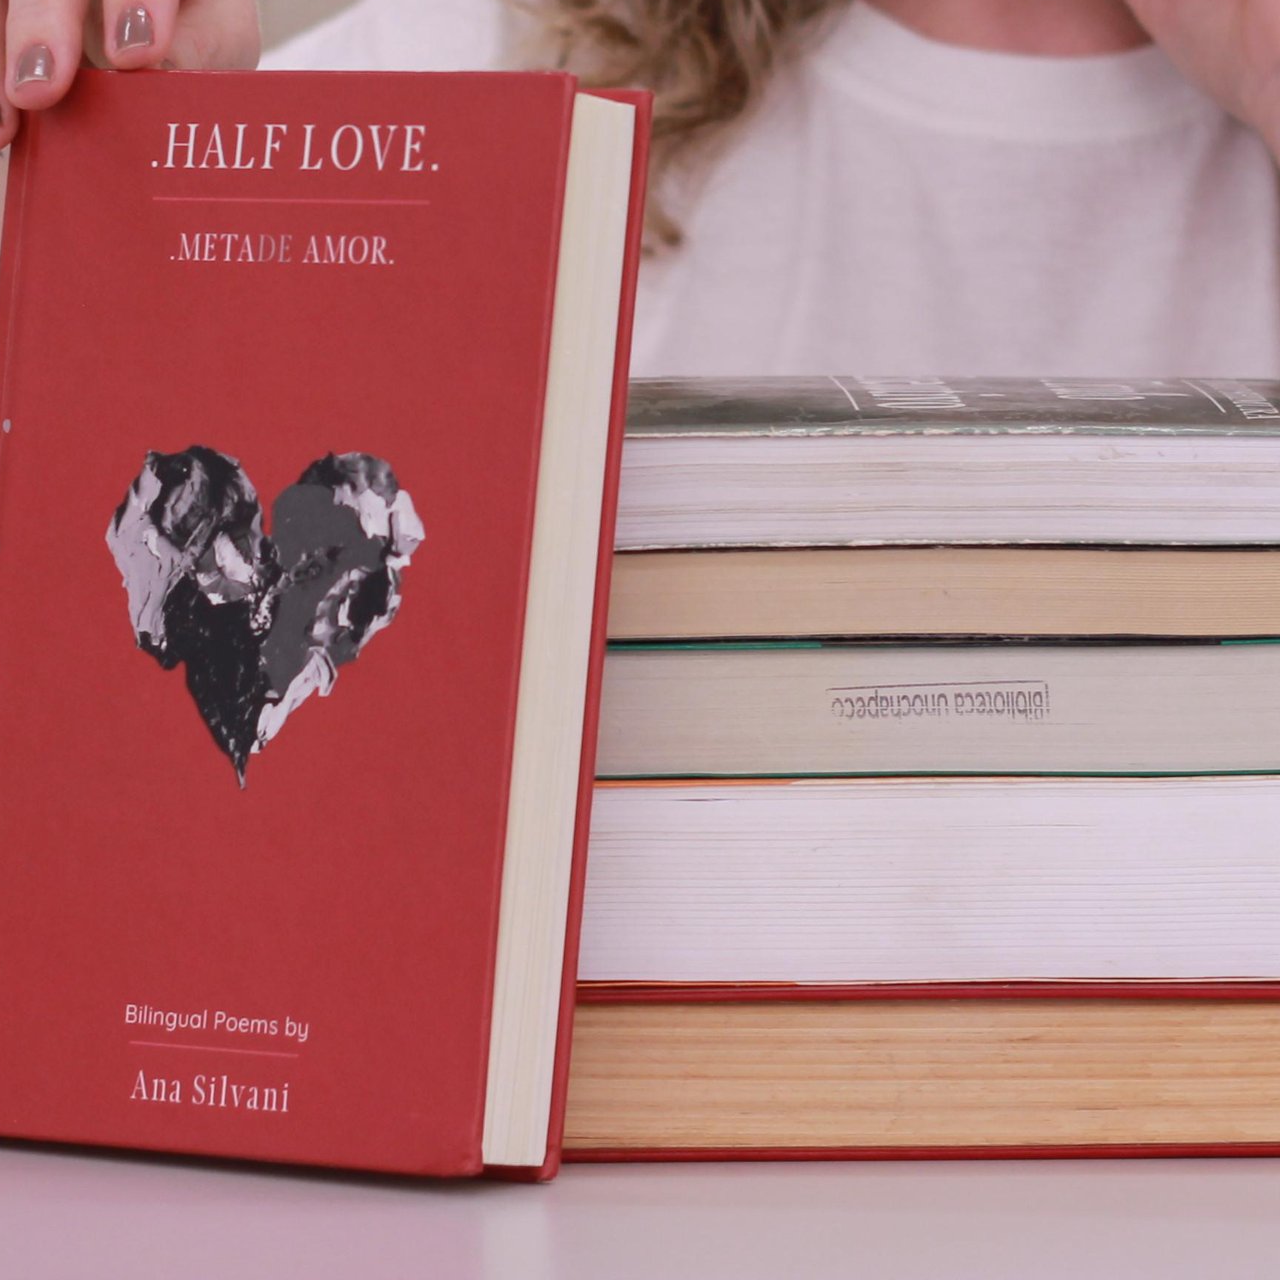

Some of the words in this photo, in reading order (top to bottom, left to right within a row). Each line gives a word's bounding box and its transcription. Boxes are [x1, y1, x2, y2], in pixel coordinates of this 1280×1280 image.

[151, 122, 288, 170] .HALF
[299, 124, 439, 171] LOVE.
[170, 233, 292, 264] .METADE
[302, 235, 395, 265] AMOR.
[953, 689, 1044, 721] Biblioteca
[124, 1004, 208, 1032] Bilingual
[213, 1011, 279, 1036] Poems
[284, 1016, 310, 1043] by
[130, 1069, 182, 1104] Ana
[191, 1074, 290, 1113] Silvani
